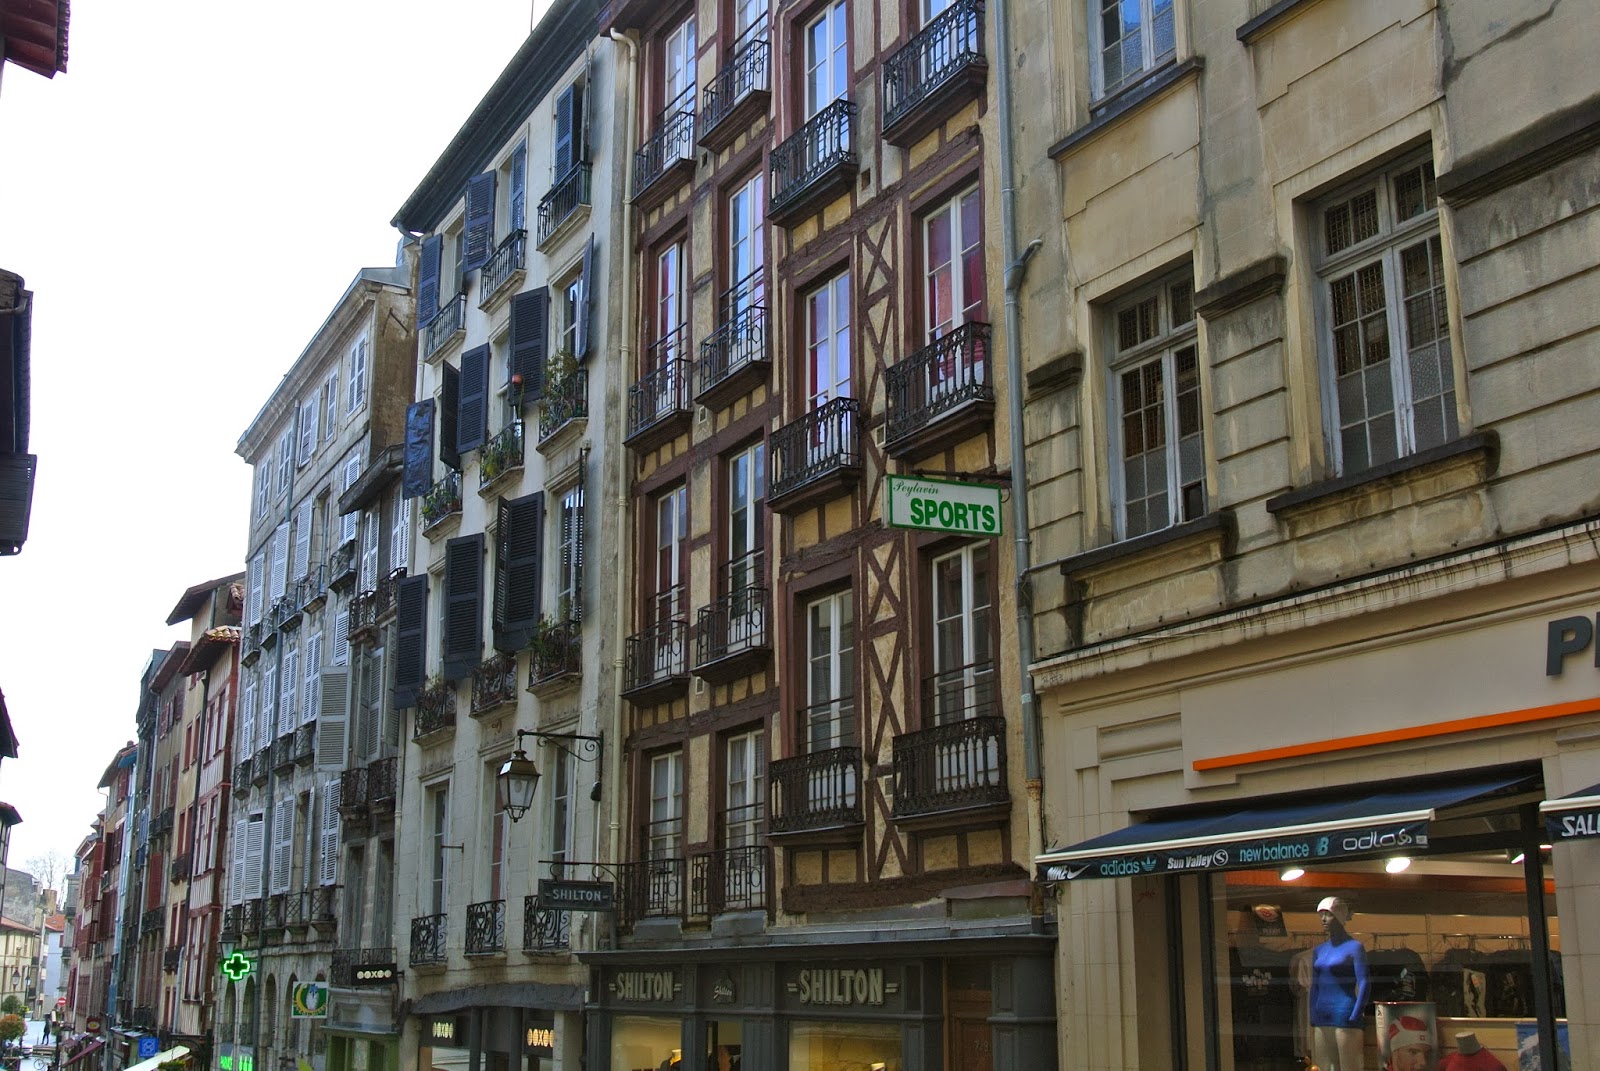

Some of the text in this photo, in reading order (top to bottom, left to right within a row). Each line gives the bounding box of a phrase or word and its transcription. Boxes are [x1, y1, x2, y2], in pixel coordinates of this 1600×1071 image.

[910, 497, 996, 531] SPORTS
[1546, 612, 1600, 676] P
[1167, 857, 1184, 869] Sun
[1186, 854, 1213, 868] Valley
[1239, 848, 1261, 862] new
[1262, 842, 1310, 861] balance
[1100, 860, 1140, 876] adidas
[553, 889, 601, 902] SHILTON
[616, 971, 674, 1002] SHILTON
[799, 968, 883, 1005] SHILTON
